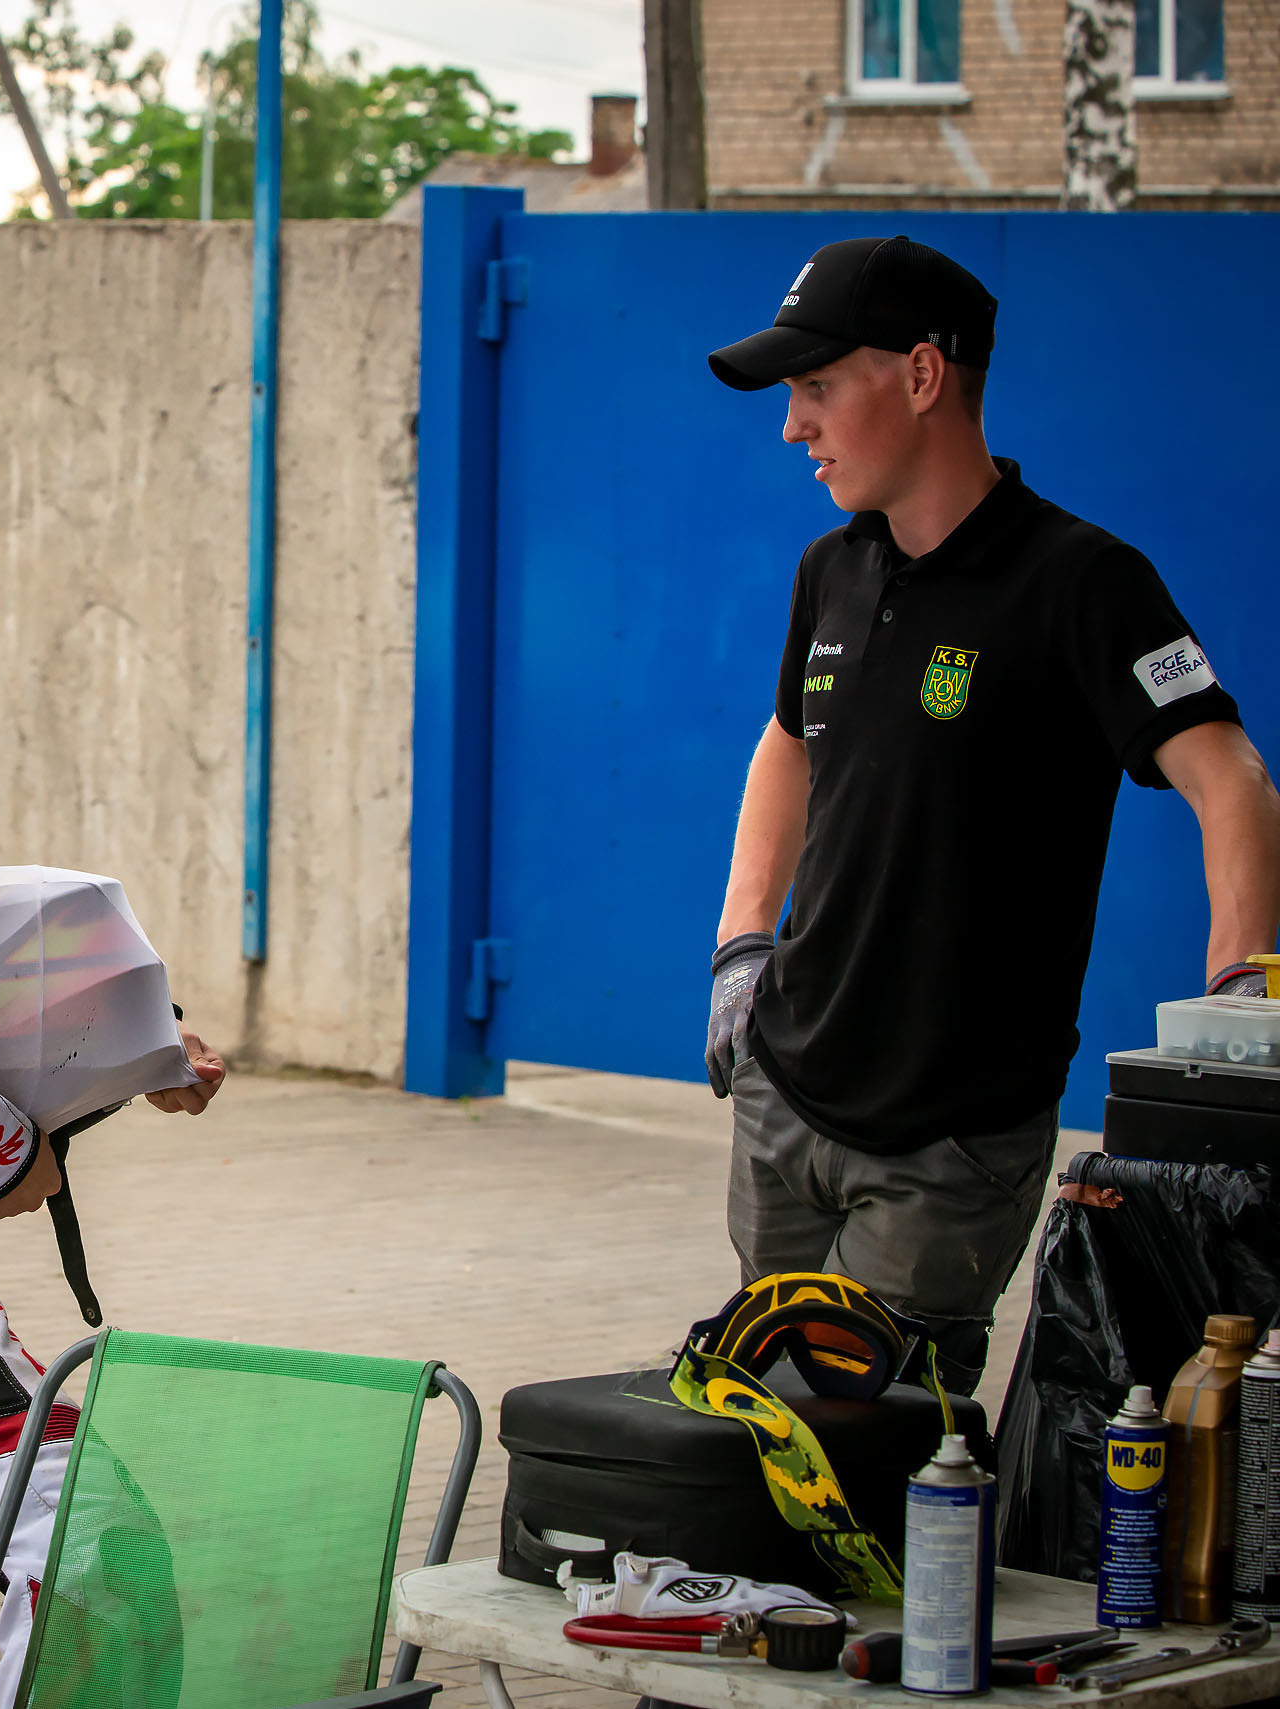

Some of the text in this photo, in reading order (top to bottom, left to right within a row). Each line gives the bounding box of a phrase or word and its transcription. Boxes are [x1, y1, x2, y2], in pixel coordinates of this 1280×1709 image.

[814, 643, 844, 658] Rybnik
[1148, 649, 1187, 679] PGE
[924, 692, 962, 714] RYBNIK
[1111, 1445, 1162, 1469] WD-40
